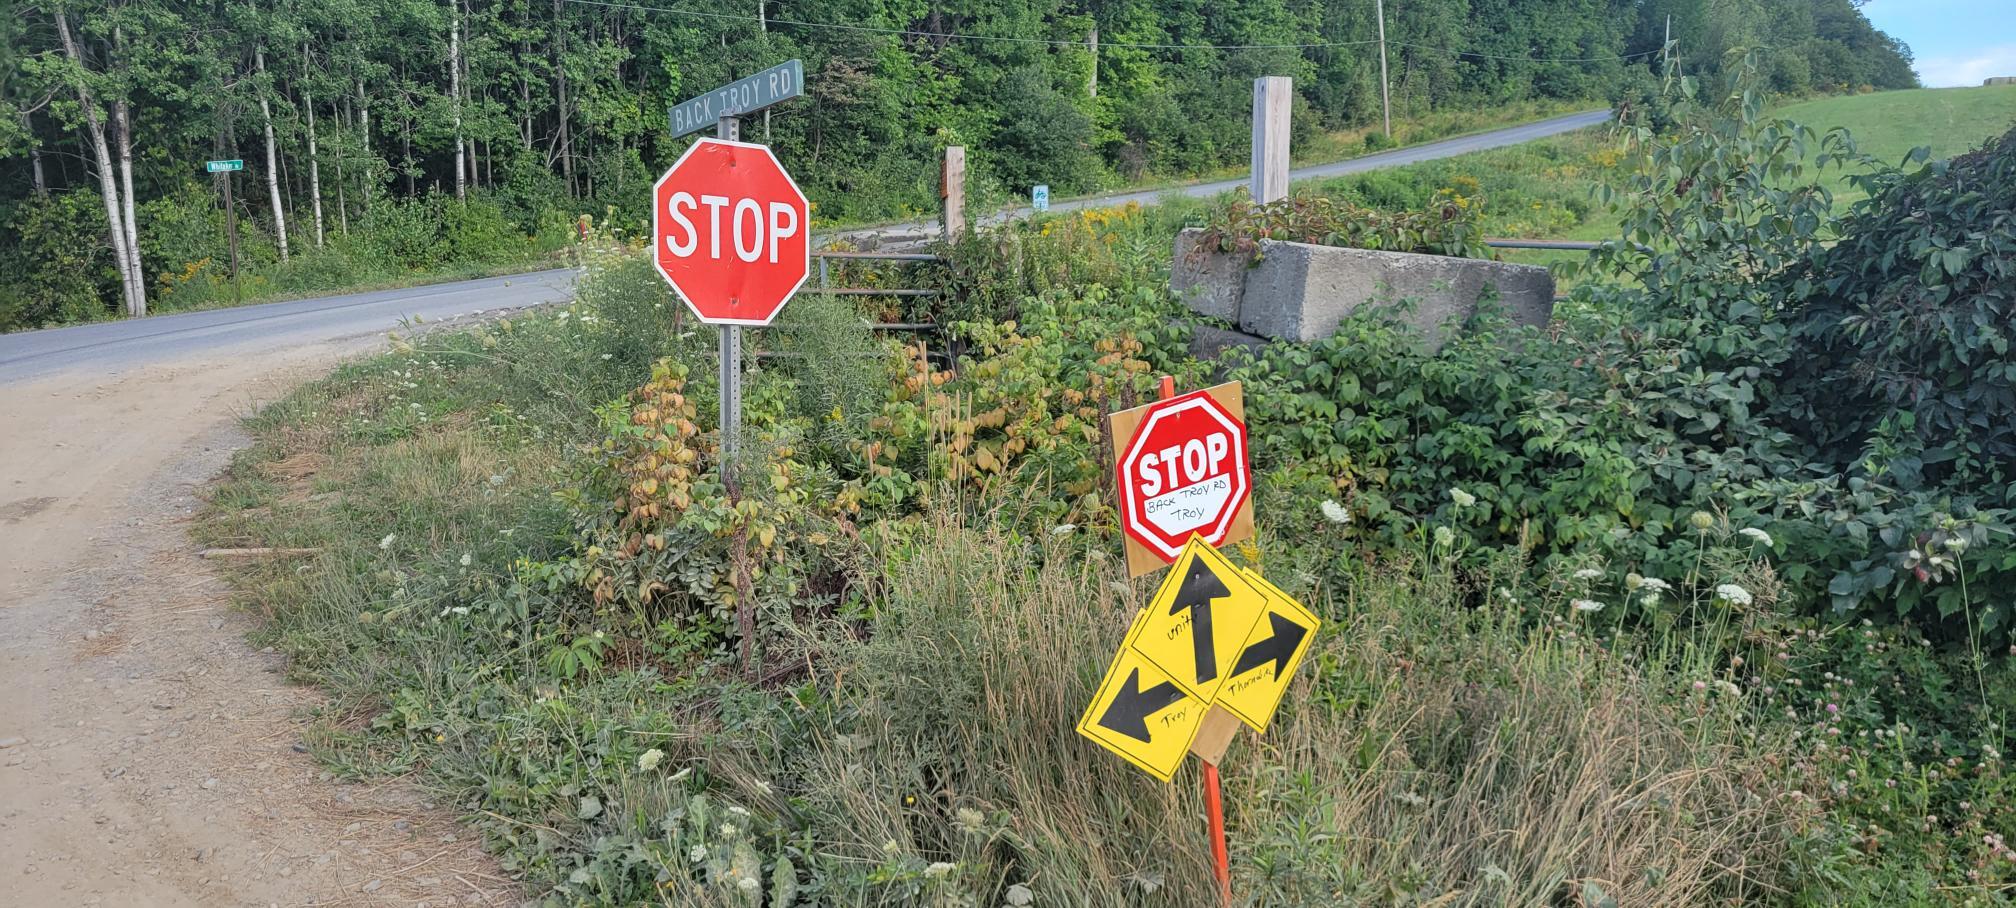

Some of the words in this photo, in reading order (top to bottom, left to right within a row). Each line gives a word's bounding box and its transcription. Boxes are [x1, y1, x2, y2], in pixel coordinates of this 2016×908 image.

[675, 97, 713, 132] BACK
[719, 79, 761, 111] TROY
[769, 68, 791, 99] RD
[666, 191, 798, 264] STOP
[1139, 432, 1229, 498] STOP
[1147, 497, 1176, 514] BACK
[1180, 484, 1210, 501] TROY
[1213, 480, 1227, 492] RD
[1170, 507, 1205, 521] TROY
[1160, 706, 1187, 728] Troy
